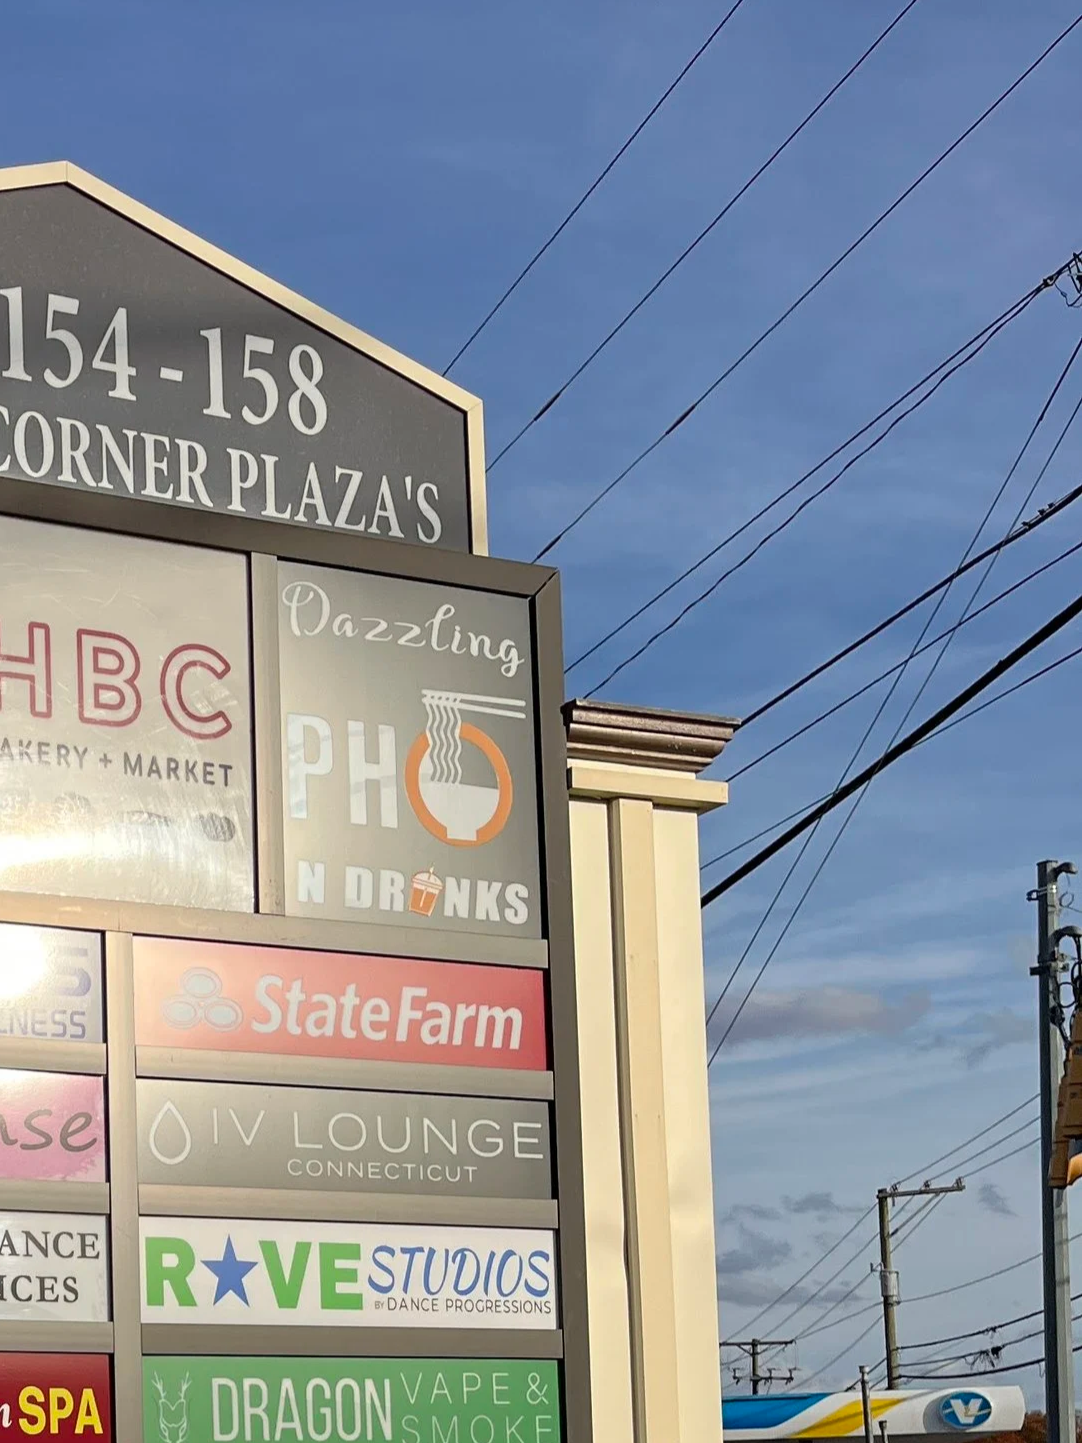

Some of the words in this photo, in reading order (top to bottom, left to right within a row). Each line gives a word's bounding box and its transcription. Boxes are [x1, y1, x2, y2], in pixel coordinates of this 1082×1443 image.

[0, 286, 137, 401] 154
[199, 327, 328, 436] 158
[226, 447, 442, 544] PLAZA'S
[282, 580, 526, 678] Dazzling
[123, 751, 234, 788] MARKET
[297, 860, 326, 904] N
[344, 865, 530, 926] DRNKS
[211, 1108, 266, 1146] IV
[293, 1111, 545, 1160] LOUNGE
[286, 1158, 478, 1182] CONNECTICUT
[367, 1245, 550, 1297] STUDIOS
[387, 1297, 440, 1313] DANCE
[445, 1299, 552, 1315] PROGRESSIONS
[18, 1385, 104, 1436] SPA
[211, 1377, 393, 1442] DRAGON
[399, 1372, 511, 1406] VAPE
[526, 1372, 549, 1406] &
